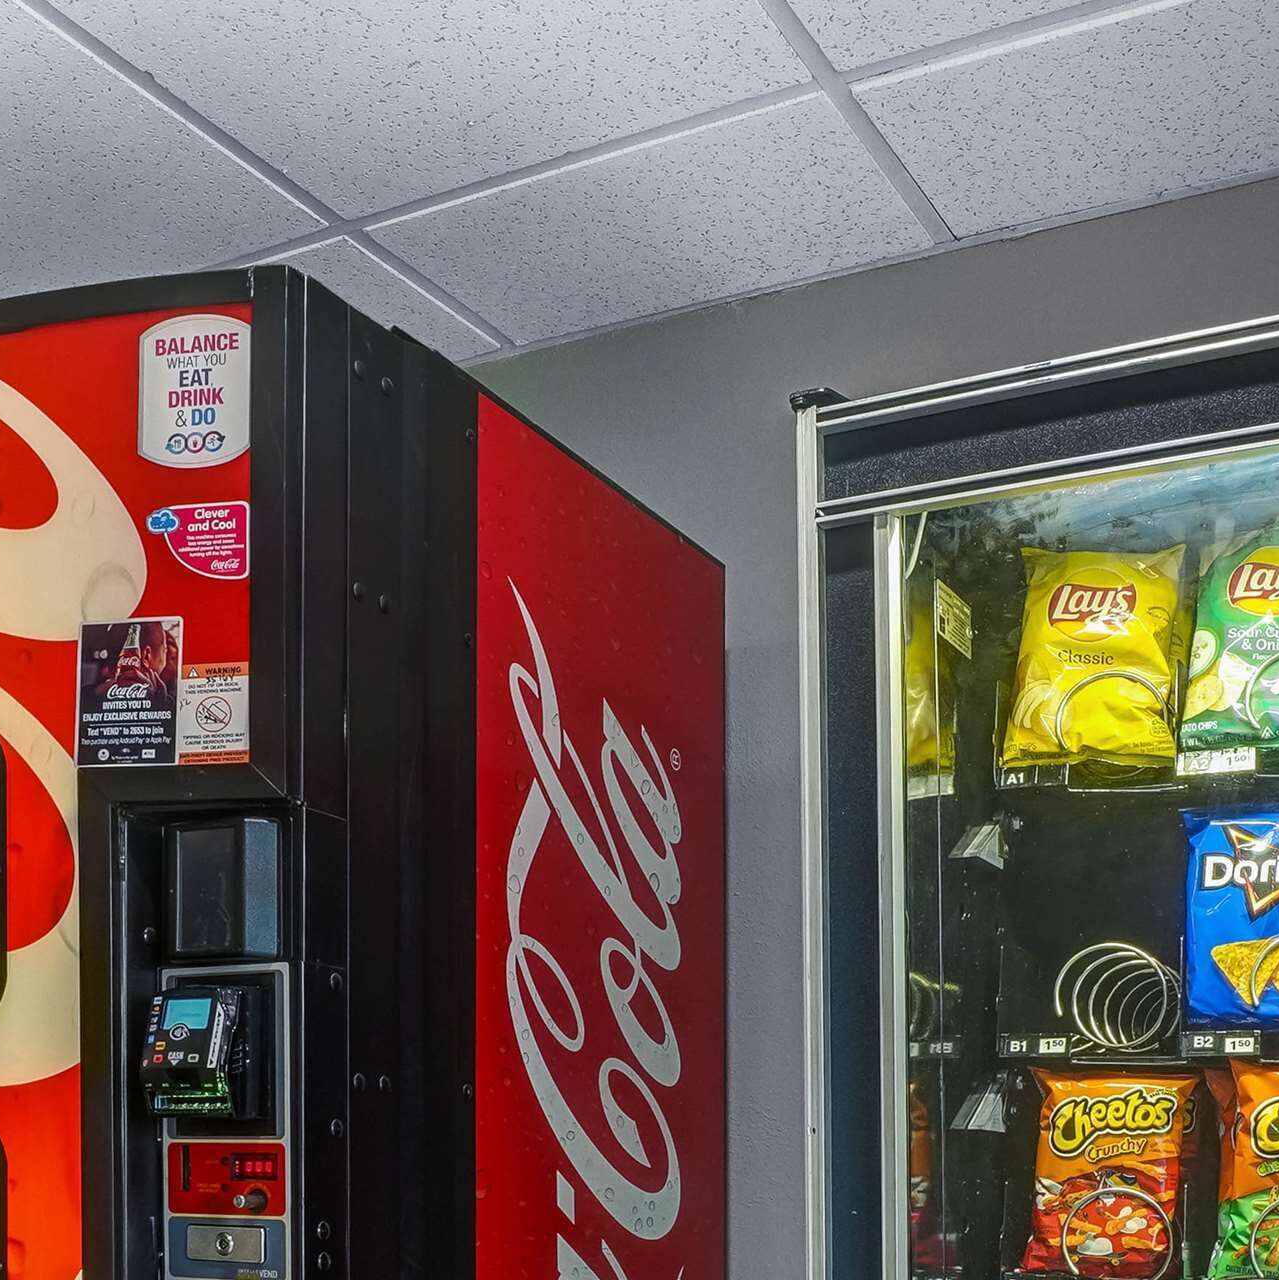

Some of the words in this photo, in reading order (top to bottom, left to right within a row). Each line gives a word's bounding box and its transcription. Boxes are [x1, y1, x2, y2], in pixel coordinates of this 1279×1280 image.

[155, 332, 240, 356] BALANCE
[167, 355, 200, 369] WHAT
[203, 353, 227, 366] YOU
[168, 387, 224, 408] DRINK
[175, 409, 187, 428] &
[191, 407, 216, 426] DO
[194, 508, 230, 519] Clever
[187, 521, 209, 532] and
[211, 518, 236, 530] Cool
[1052, 584, 1135, 621] Lay's
[1228, 627, 1261, 639] Sour
[1241, 639, 1253, 651] &
[1058, 649, 1114, 665] Classic
[205, 666, 241, 675] WARNING
[128, 700, 141, 709] YOU
[142, 700, 151, 709] TO
[1006, 772, 1025, 785] A1
[1010, 1040, 1027, 1052] B1
[1194, 1036, 1214, 1049] B2
[1052, 1091, 1177, 1153] Cheetos
[1086, 1138, 1146, 1163] Crunchy
